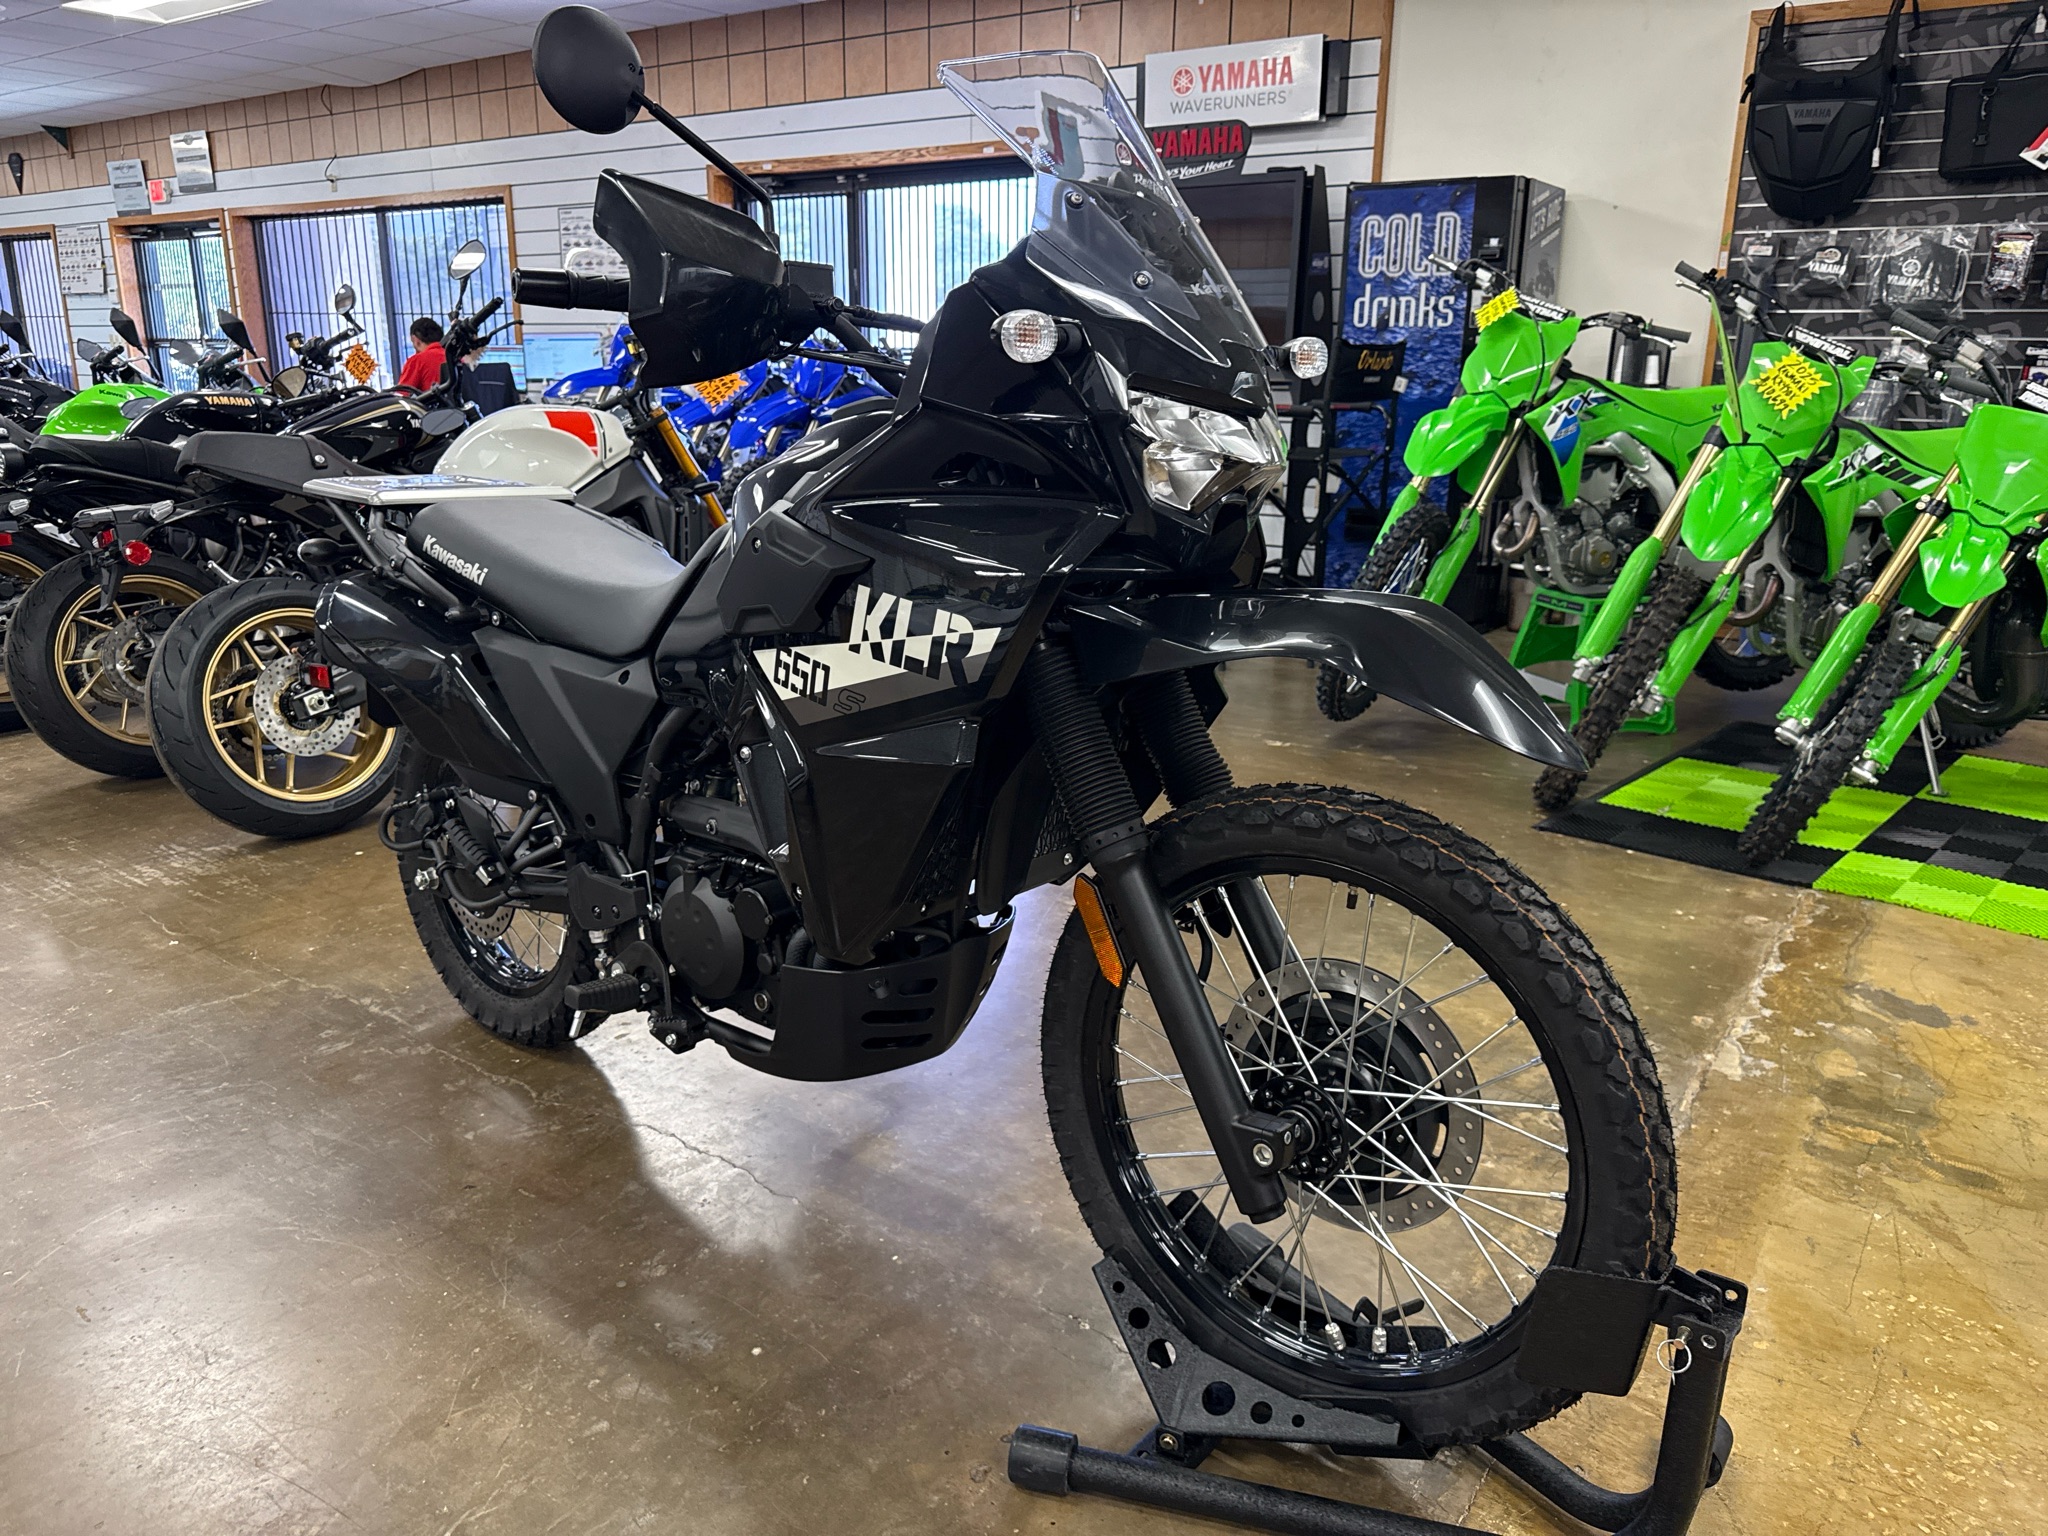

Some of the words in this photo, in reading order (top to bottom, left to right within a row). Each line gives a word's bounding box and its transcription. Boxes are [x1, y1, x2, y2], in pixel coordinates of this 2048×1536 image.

[1198, 55, 1294, 93] YAMAHA
[1170, 90, 1287, 115] WAVERUNNERS
[1793, 107, 1832, 119] YAMAHA
[1152, 123, 1244, 158] YAMAHA
[1179, 165, 1204, 180] Your
[1203, 159, 1234, 173] Heart
[1357, 211, 1462, 279] COLD
[1352, 283, 1455, 328] drinks
[1786, 359, 1819, 386] 2025
[203, 395, 253, 408] YAMAHA
[422, 533, 489, 586] Kawasaki
[848, 583, 974, 688] KLR
[773, 646, 831, 707] 650
[832, 688, 867, 717] S
